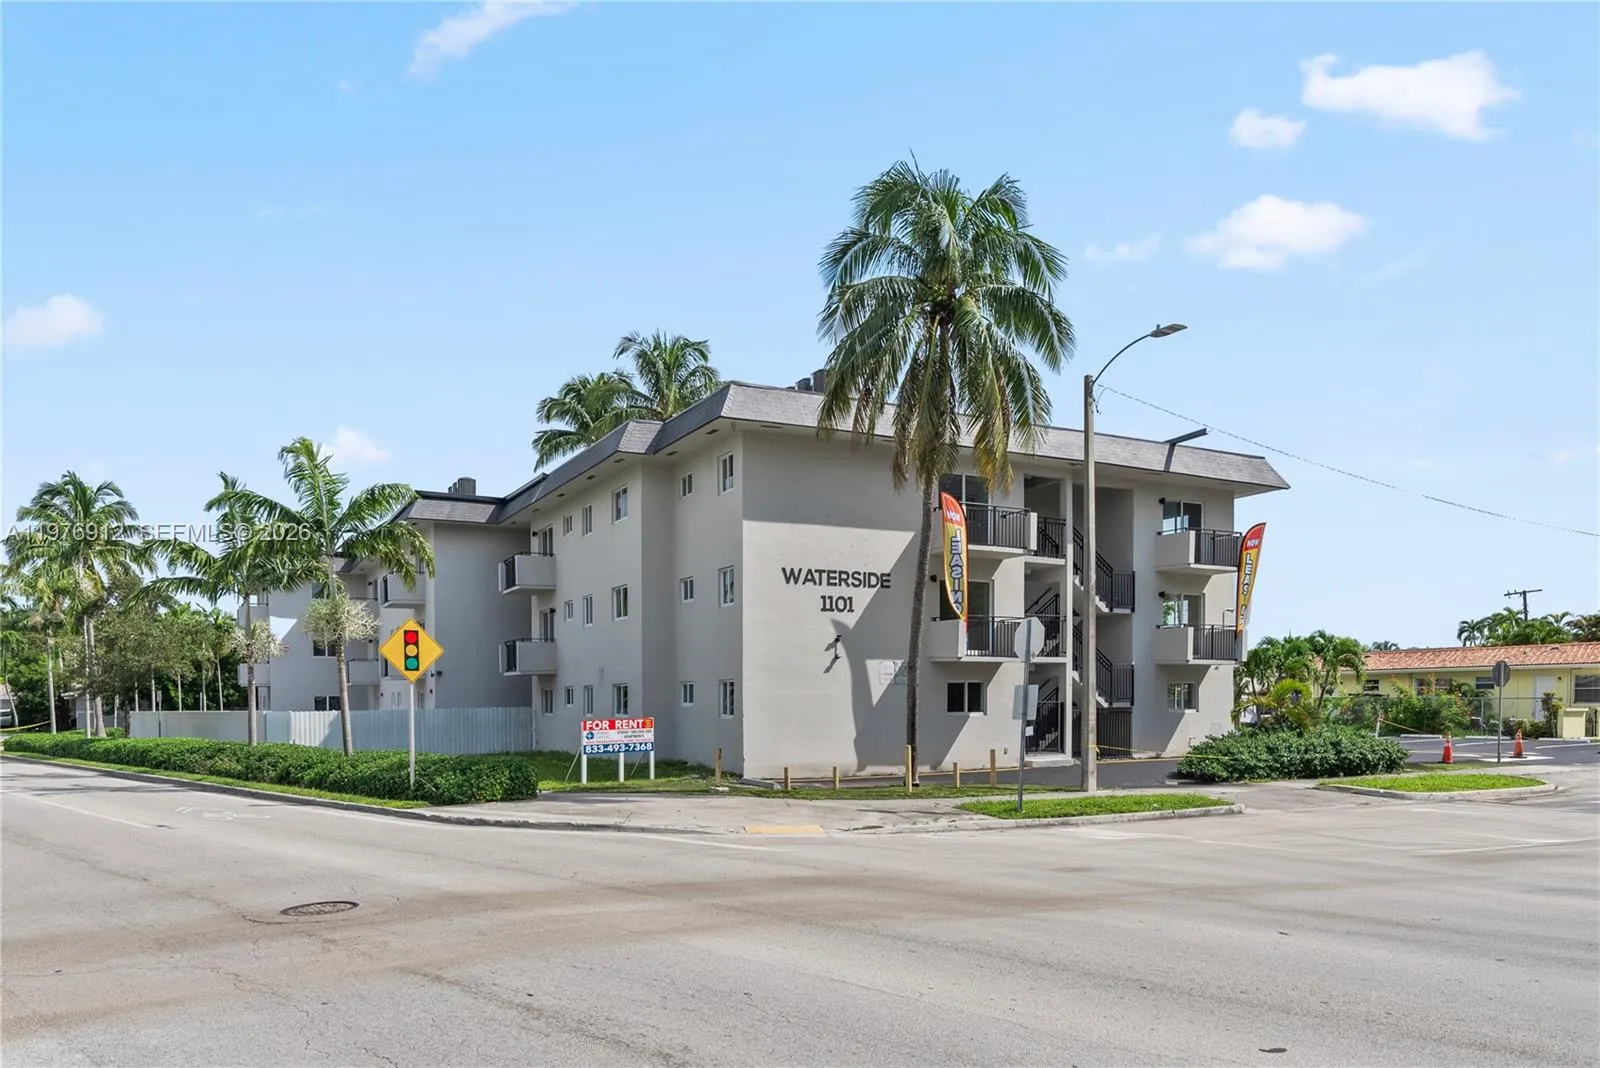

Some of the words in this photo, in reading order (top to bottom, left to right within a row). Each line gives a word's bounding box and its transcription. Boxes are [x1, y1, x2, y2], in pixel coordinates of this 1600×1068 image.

[781, 567, 891, 589] WATERSIDE
[820, 595, 854, 613] 1101
[586, 720, 609, 730] FOR
[615, 719, 643, 729] RENT
[585, 743, 652, 753] 833-493-7368
